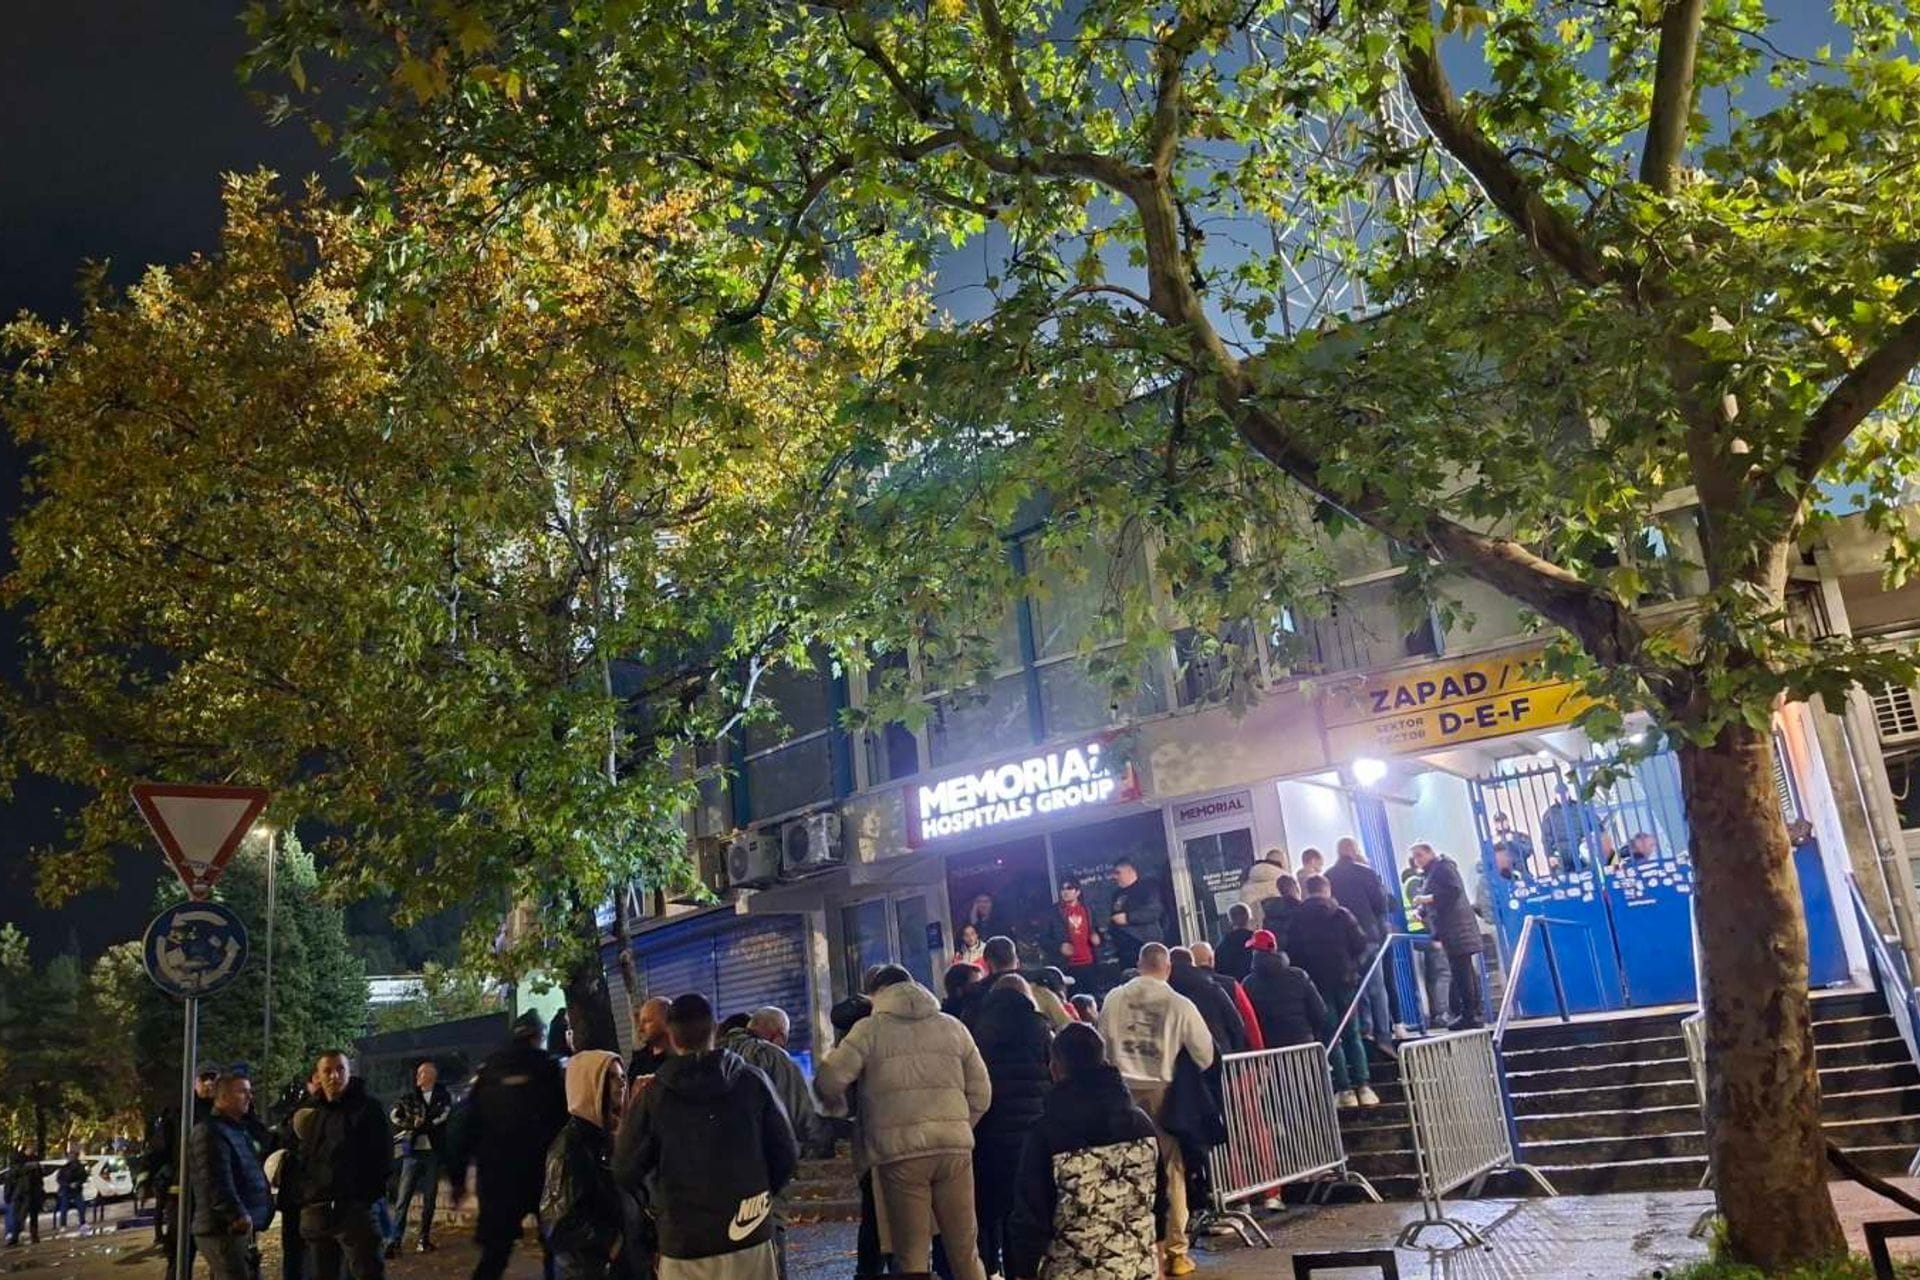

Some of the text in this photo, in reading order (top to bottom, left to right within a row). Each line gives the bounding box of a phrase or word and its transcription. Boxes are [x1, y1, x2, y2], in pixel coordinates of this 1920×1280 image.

[1370, 671, 1487, 713] ZAPAD
[1438, 697, 1531, 735] D-E-F
[921, 777, 1116, 841] HOSPITALS GROUP
[1180, 799, 1245, 821] MEMORIAL
